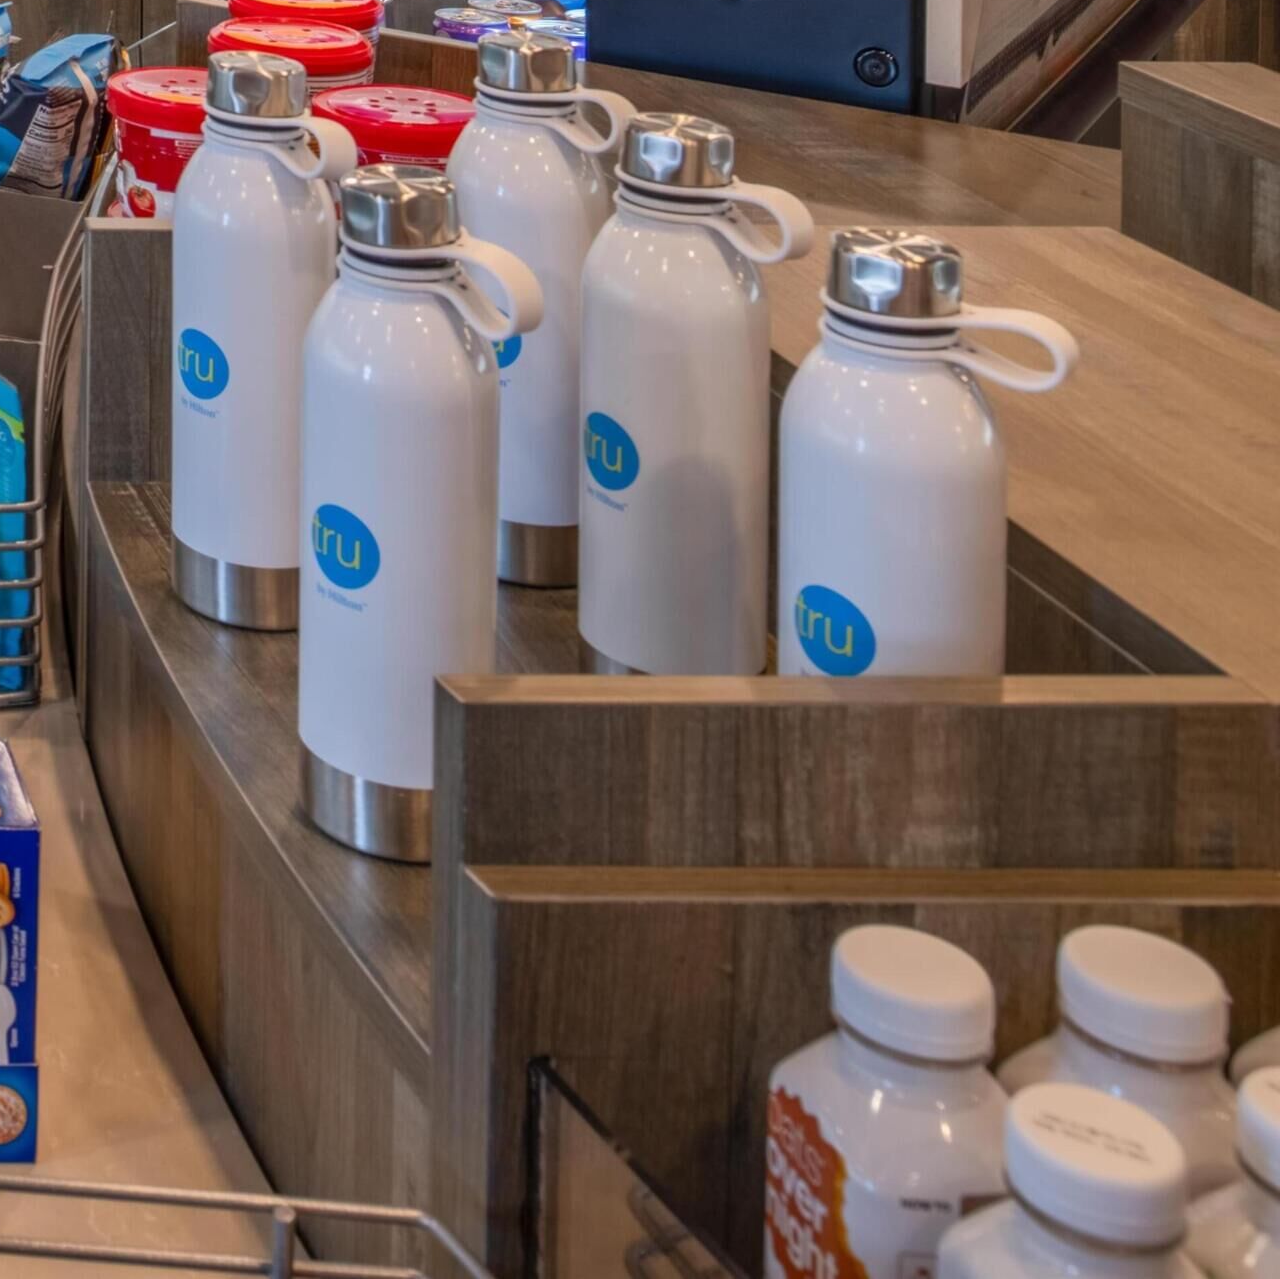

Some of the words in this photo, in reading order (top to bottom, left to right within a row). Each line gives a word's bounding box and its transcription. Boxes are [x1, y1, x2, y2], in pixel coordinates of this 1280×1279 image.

[178, 343, 214, 383] tru
[583, 427, 623, 474] tru
[312, 512, 360, 570] tru
[795, 596, 854, 658] tru
